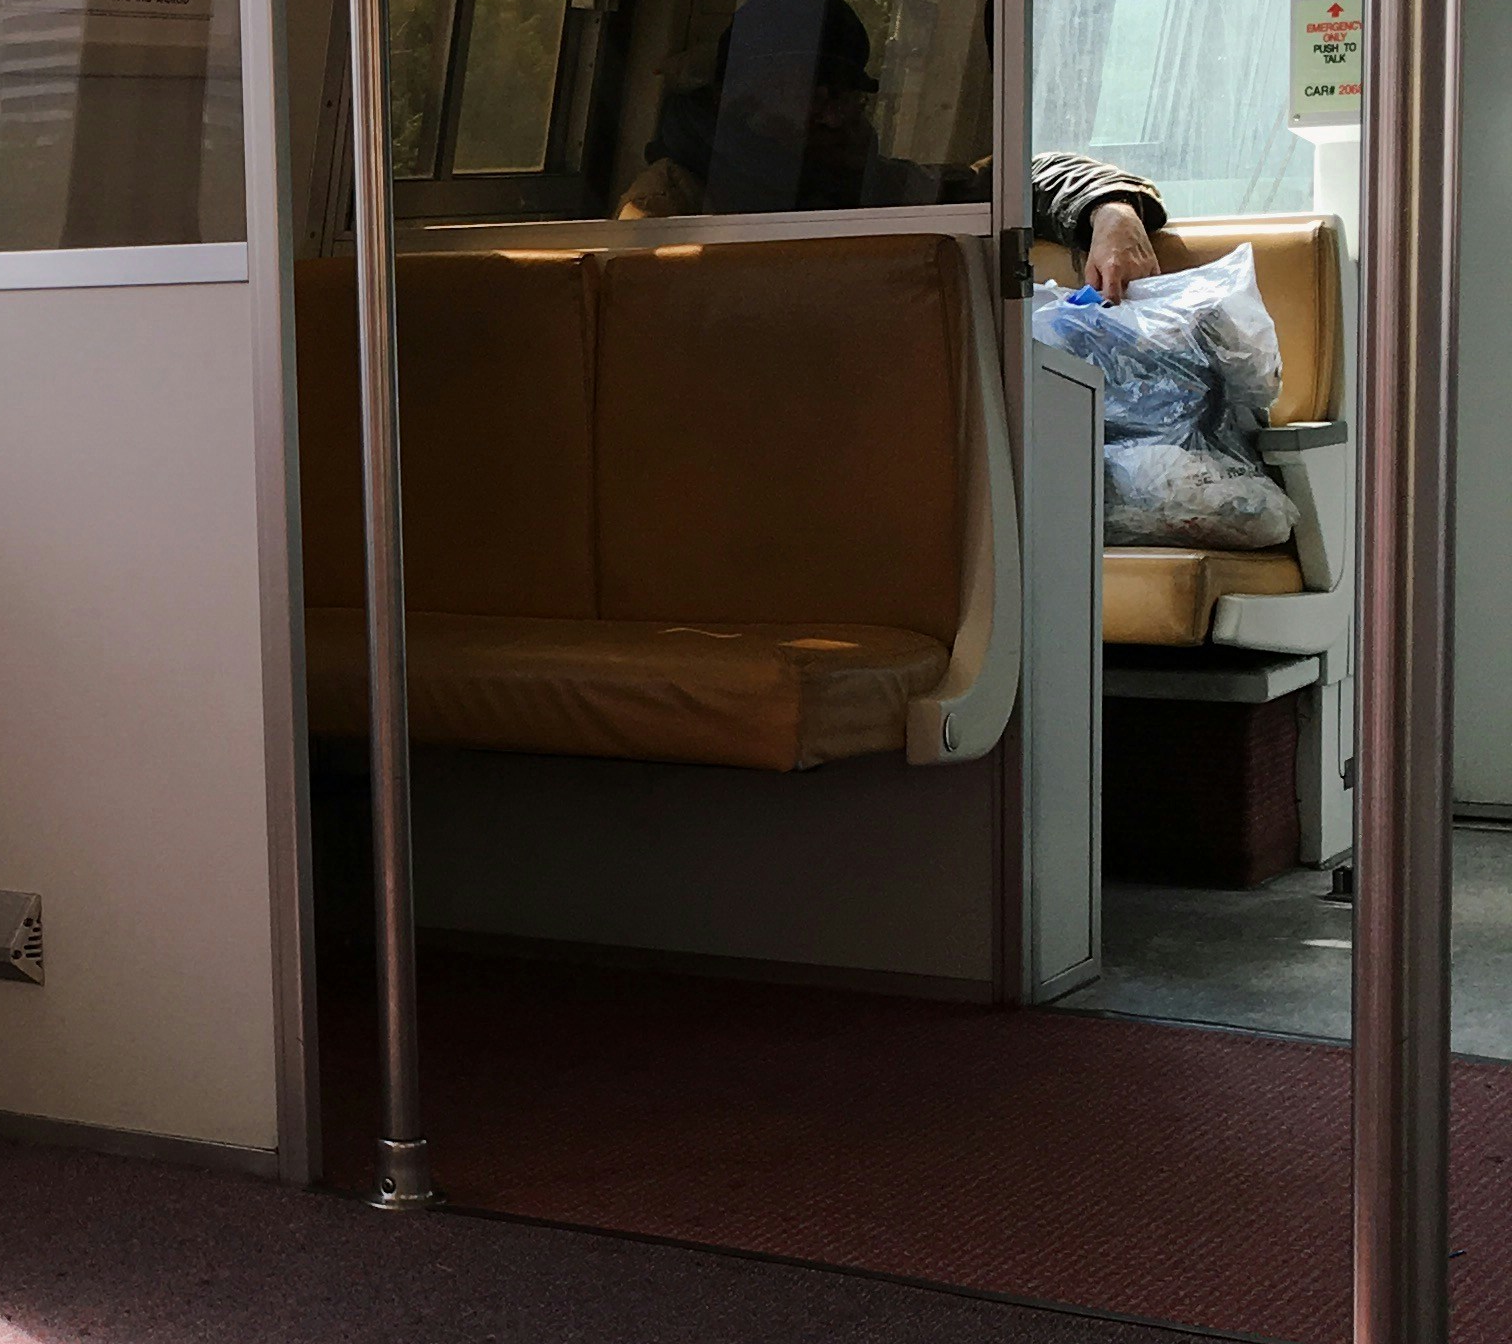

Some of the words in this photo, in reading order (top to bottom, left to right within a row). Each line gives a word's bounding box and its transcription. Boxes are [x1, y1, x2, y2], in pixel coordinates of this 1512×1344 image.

[1322, 32, 1348, 43] ONLY
[1313, 43, 1339, 54] PUSH
[1344, 42, 1357, 53] TO
[1323, 53, 1346, 64] TALK
[1304, 85, 1336, 97] CAR#
